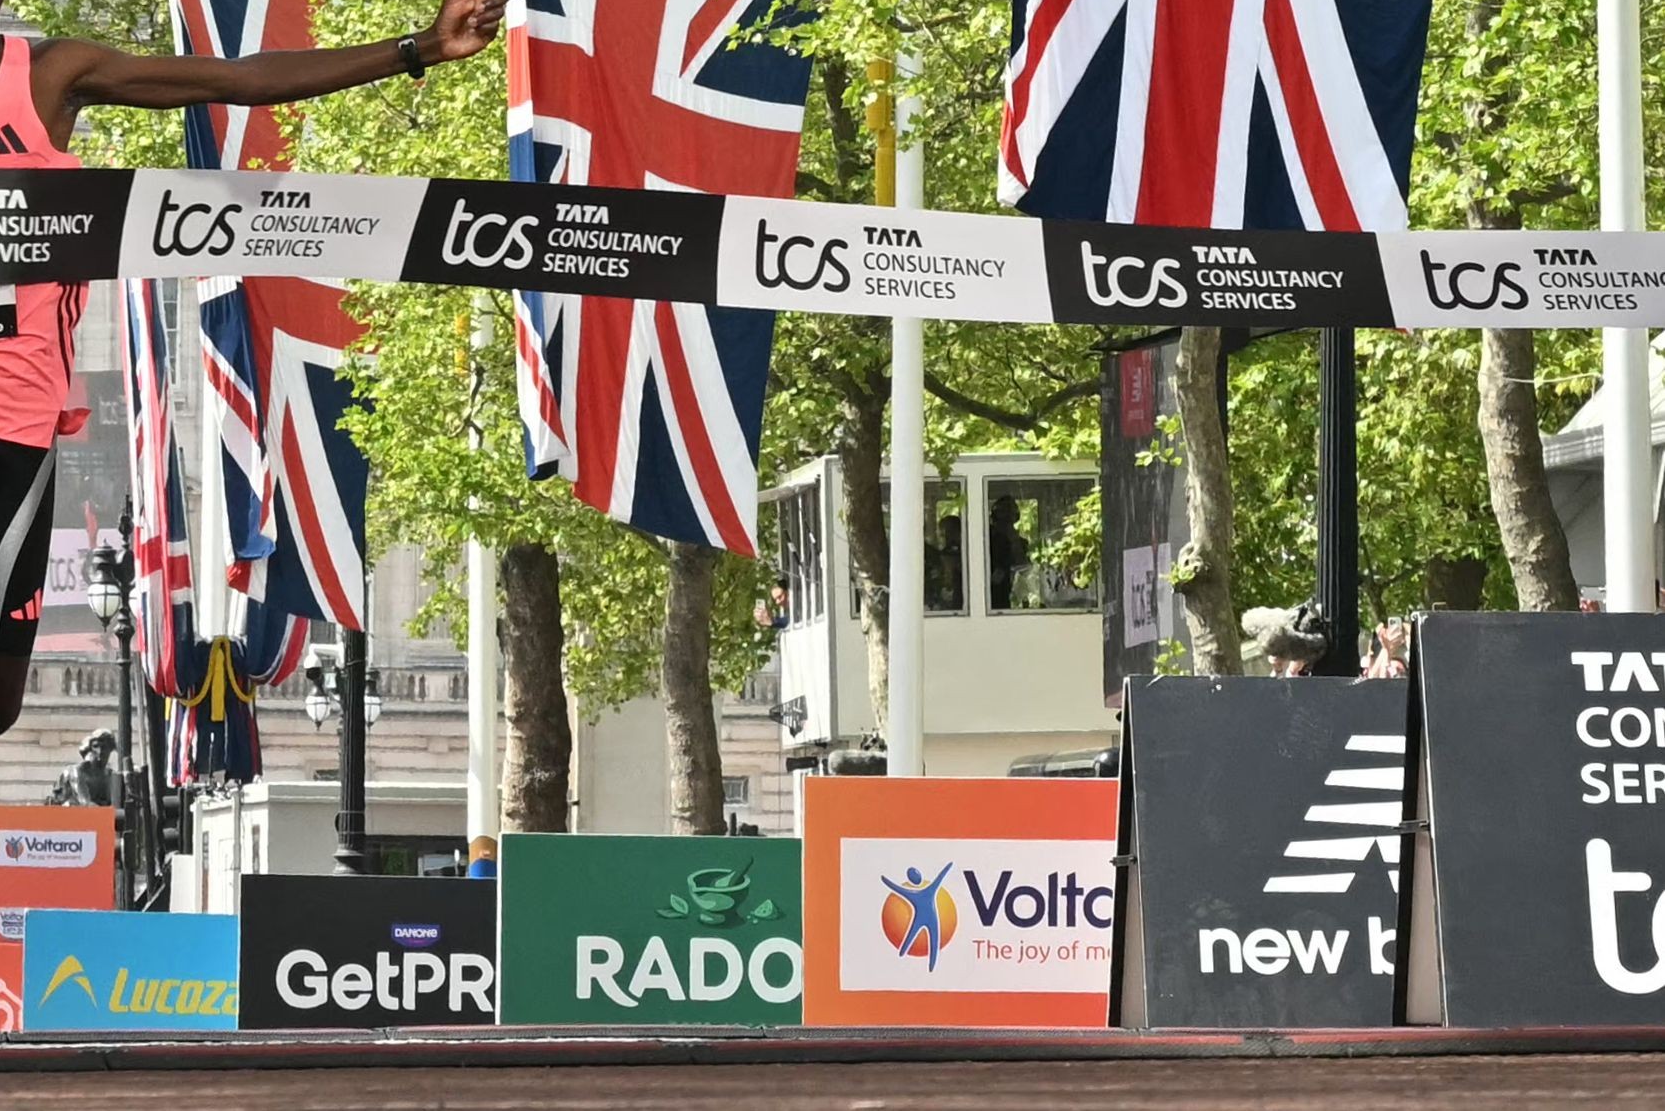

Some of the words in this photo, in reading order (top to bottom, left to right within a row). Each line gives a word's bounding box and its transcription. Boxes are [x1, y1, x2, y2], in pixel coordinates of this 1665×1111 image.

[260, 190, 311, 208] TATA
[152, 189, 243, 257] tcs
[250, 214, 381, 236] CONSULTANCY
[555, 203, 609, 225] TATA
[442, 198, 539, 270] tcs
[547, 227, 683, 256] CONSULTANCY
[863, 226, 923, 248] TATA
[242, 238, 325, 258] SERVICES
[756, 218, 851, 293] tcs
[1192, 246, 1257, 265] TATA
[1533, 248, 1598, 265] TATA
[542, 252, 630, 278] SERVICES
[863, 252, 1006, 278] CONSULTANCY
[1081, 240, 1188, 308] tcs
[864, 277, 956, 300] SERVICES
[1196, 269, 1344, 289] CONSULTANCY
[1420, 249, 1529, 311] tcs
[1200, 292, 1297, 311] SERVICES
[1542, 294, 1638, 311] SERVICES
[1575, 706, 1665, 748] CO
[25, 836, 83, 853] Voltarol
[972, 939, 1013, 960] The
[1017, 940, 1051, 964] joy
[1057, 940, 1080, 961] of
[1086, 946, 1110, 960] m
[1199, 926, 1350, 976] new
[275, 948, 495, 1013] GetPR
[576, 935, 803, 1008] RADO
